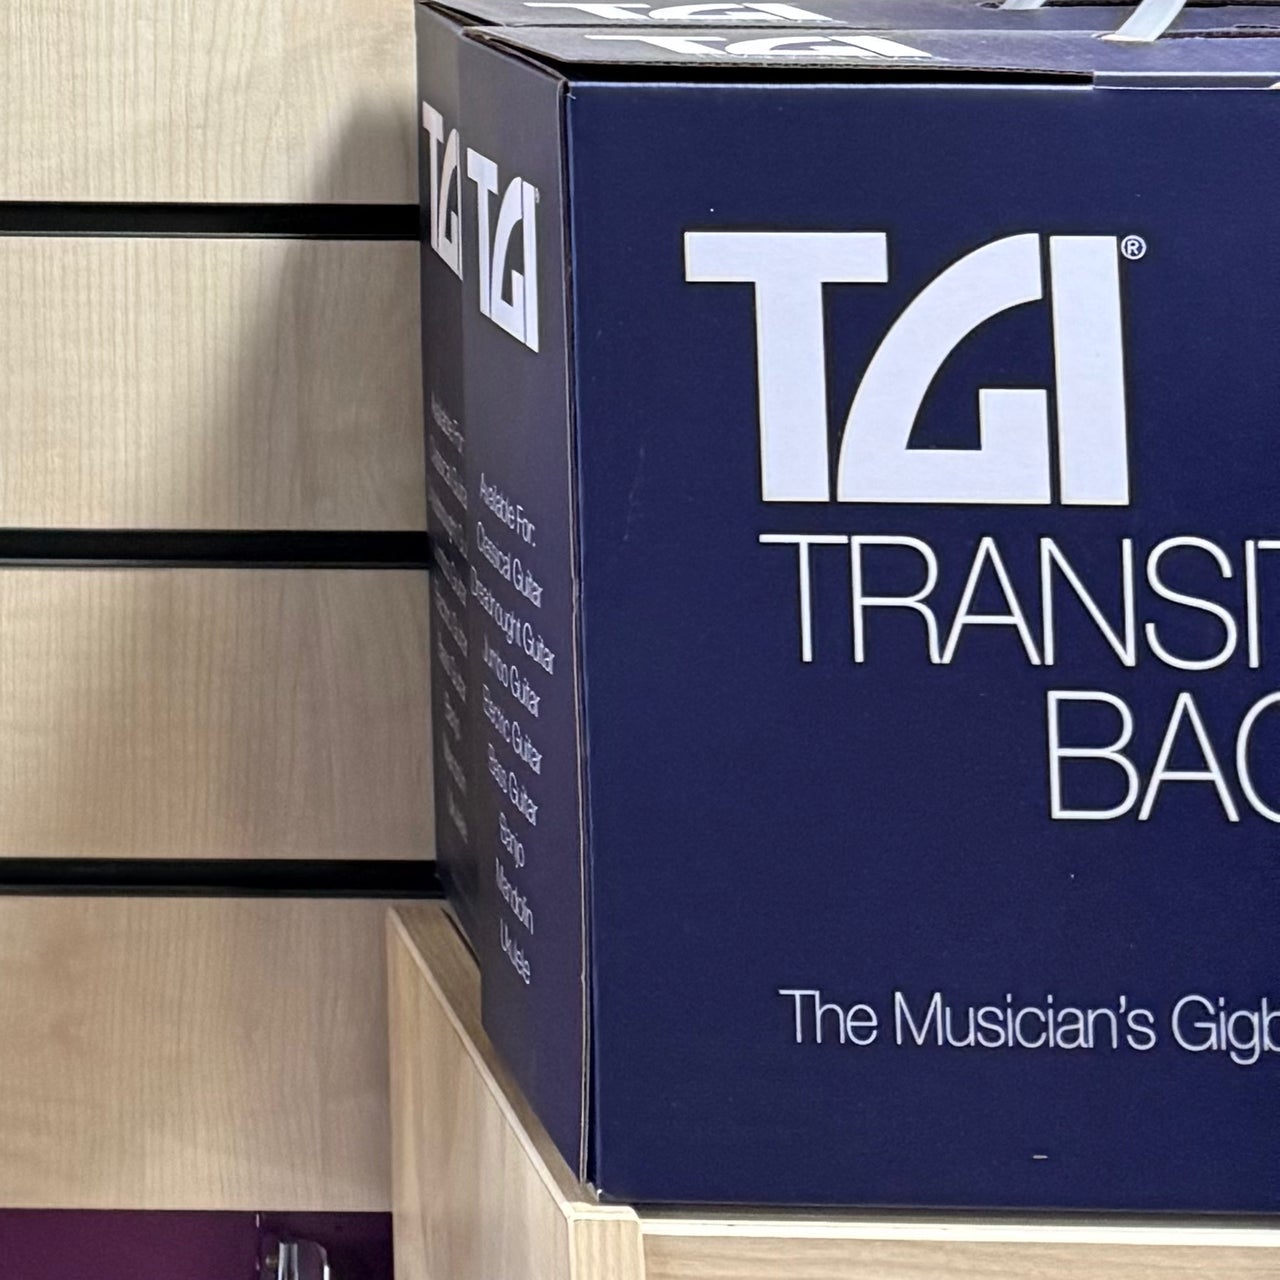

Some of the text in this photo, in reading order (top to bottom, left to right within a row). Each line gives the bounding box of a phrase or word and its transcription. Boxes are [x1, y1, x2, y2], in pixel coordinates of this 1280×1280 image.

[585, 34, 933, 58] TGI
[422, 100, 463, 281] TG
[467, 147, 539, 353] TGI
[684, 231, 1130, 506] TGI
[512, 558, 543, 608] Guitar
[759, 533, 1280, 671] TRANSI
[522, 622, 555, 675] Guitar
[510, 665, 540, 718] Guitar
[511, 721, 542, 775] Guitar
[509, 771, 538, 826] Guitar
[778, 988, 878, 1046] The
[894, 990, 1157, 1051] Musician's
